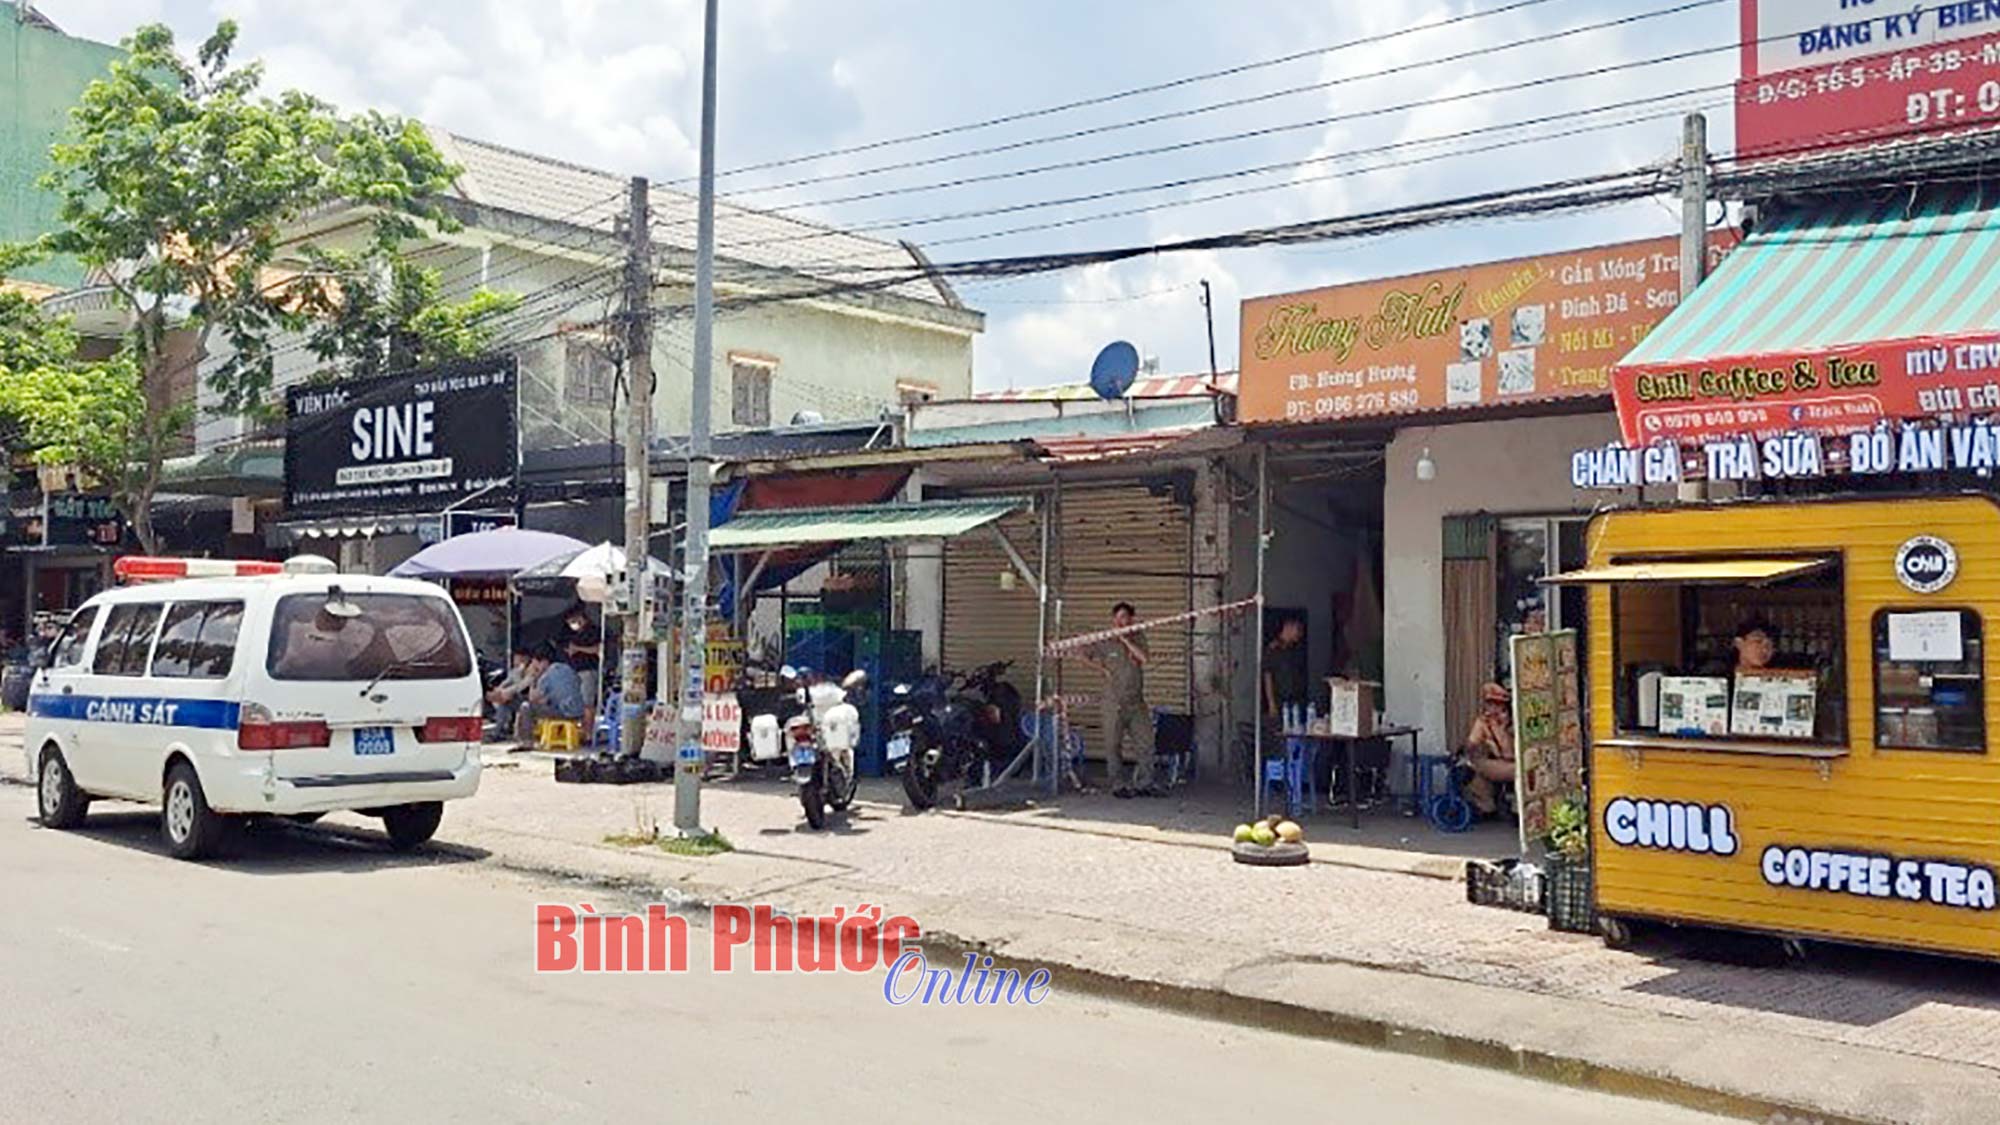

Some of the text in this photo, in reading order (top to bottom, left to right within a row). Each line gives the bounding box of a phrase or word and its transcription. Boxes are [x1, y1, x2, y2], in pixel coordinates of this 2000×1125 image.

[1885, 5, 1923, 39] KÝ
[1929, 50, 1961, 73] 3B
[1907, 89, 1965, 123] ĐT:
[1600, 256, 1646, 282] Móng
[1561, 296, 1600, 319] Đính
[1605, 293, 1628, 314] Đá
[1647, 288, 1678, 308] Sơn
[1700, 366, 1785, 400] Coffee
[1792, 359, 1819, 387] &
[1827, 357, 1878, 386] Tea
[351, 401, 435, 461] SINE
[1571, 441, 1638, 488] CHÂN
[1644, 440, 1680, 484] GÀ
[1704, 436, 1757, 481] TRÀ
[1763, 432, 1821, 478] SỮA
[1899, 421, 1944, 471] ĂN
[139, 699, 179, 725] SÁT
[1605, 799, 1736, 854] CHILL
[1762, 847, 1995, 908] COFFEE & TEA
